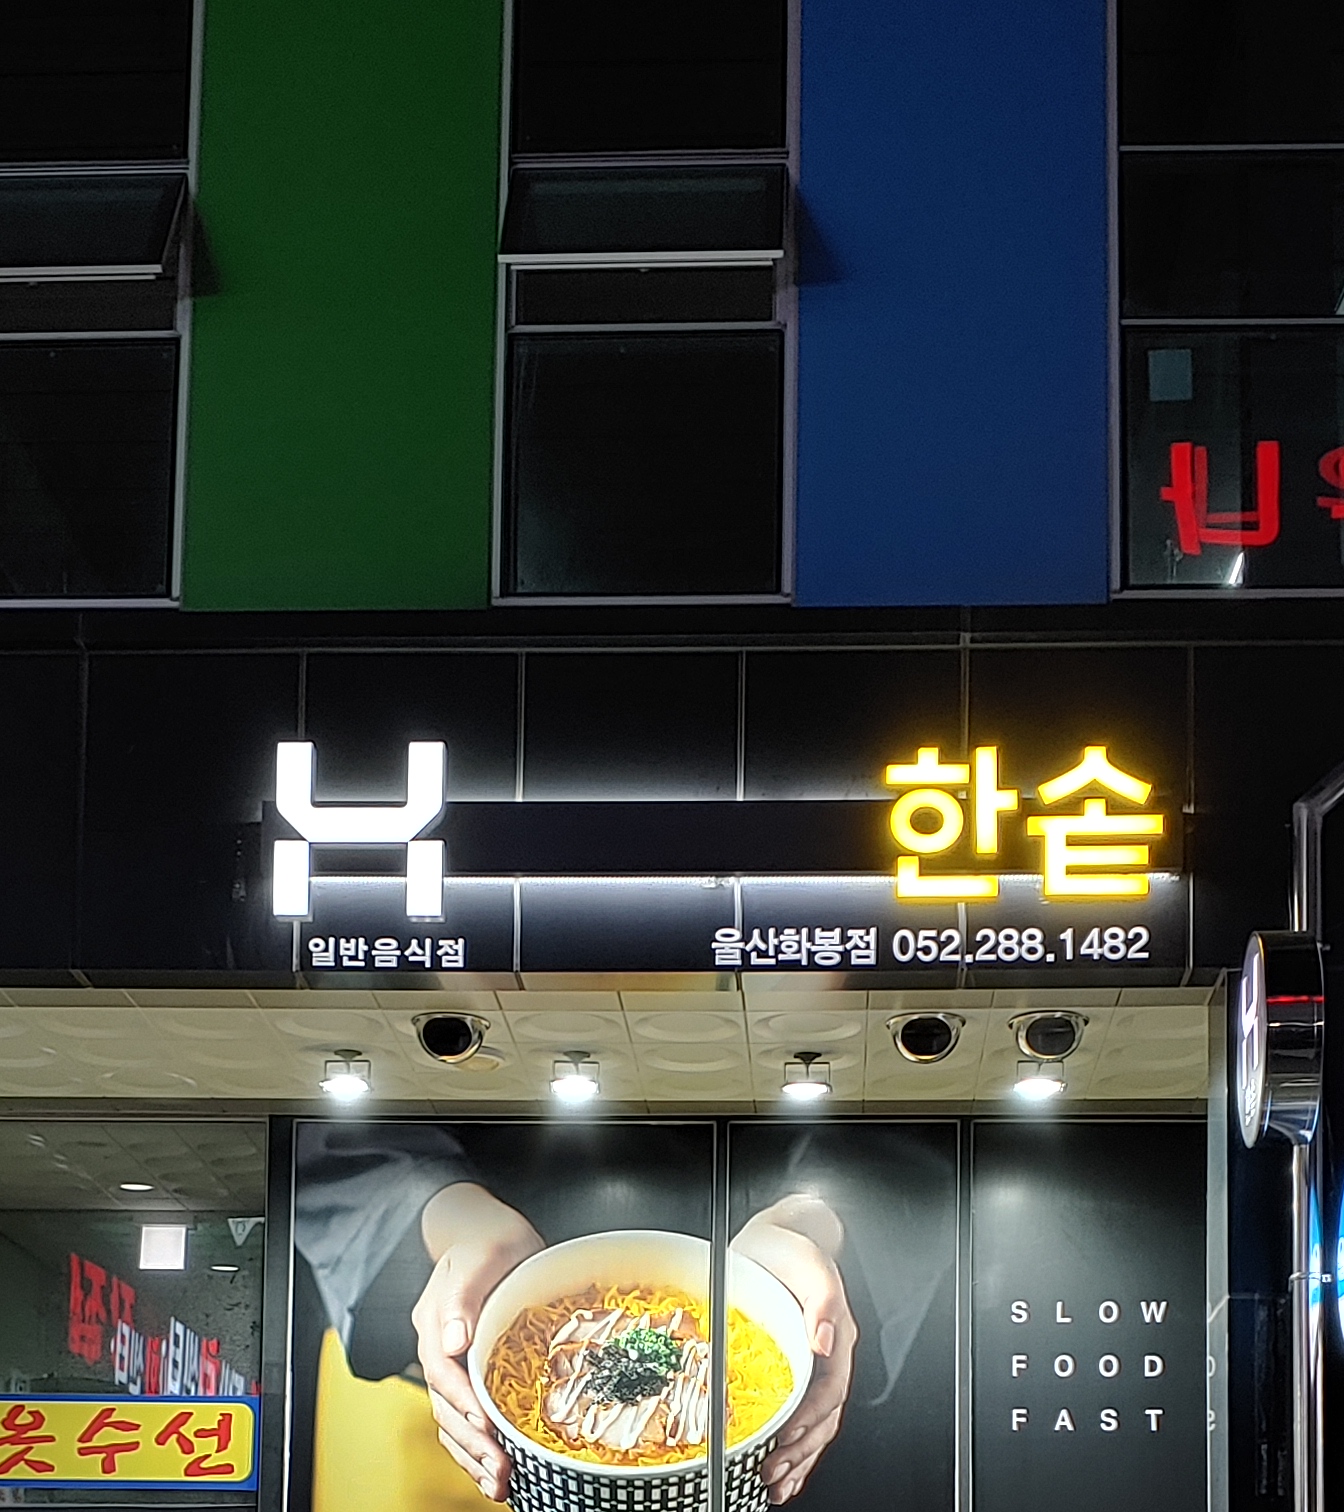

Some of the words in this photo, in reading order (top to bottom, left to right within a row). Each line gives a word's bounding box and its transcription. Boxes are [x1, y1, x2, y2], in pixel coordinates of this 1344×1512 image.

[884, 744, 1165, 901] 한솥
[307, 936, 466, 968] 일반음식점
[711, 927, 878, 967] 울산화봉점
[892, 927, 1150, 964] 052.288.1482
[1010, 1300, 1168, 1324] SLOW
[1011, 1354, 1166, 1378] FOOD
[1011, 1408, 1164, 1432] FAST
